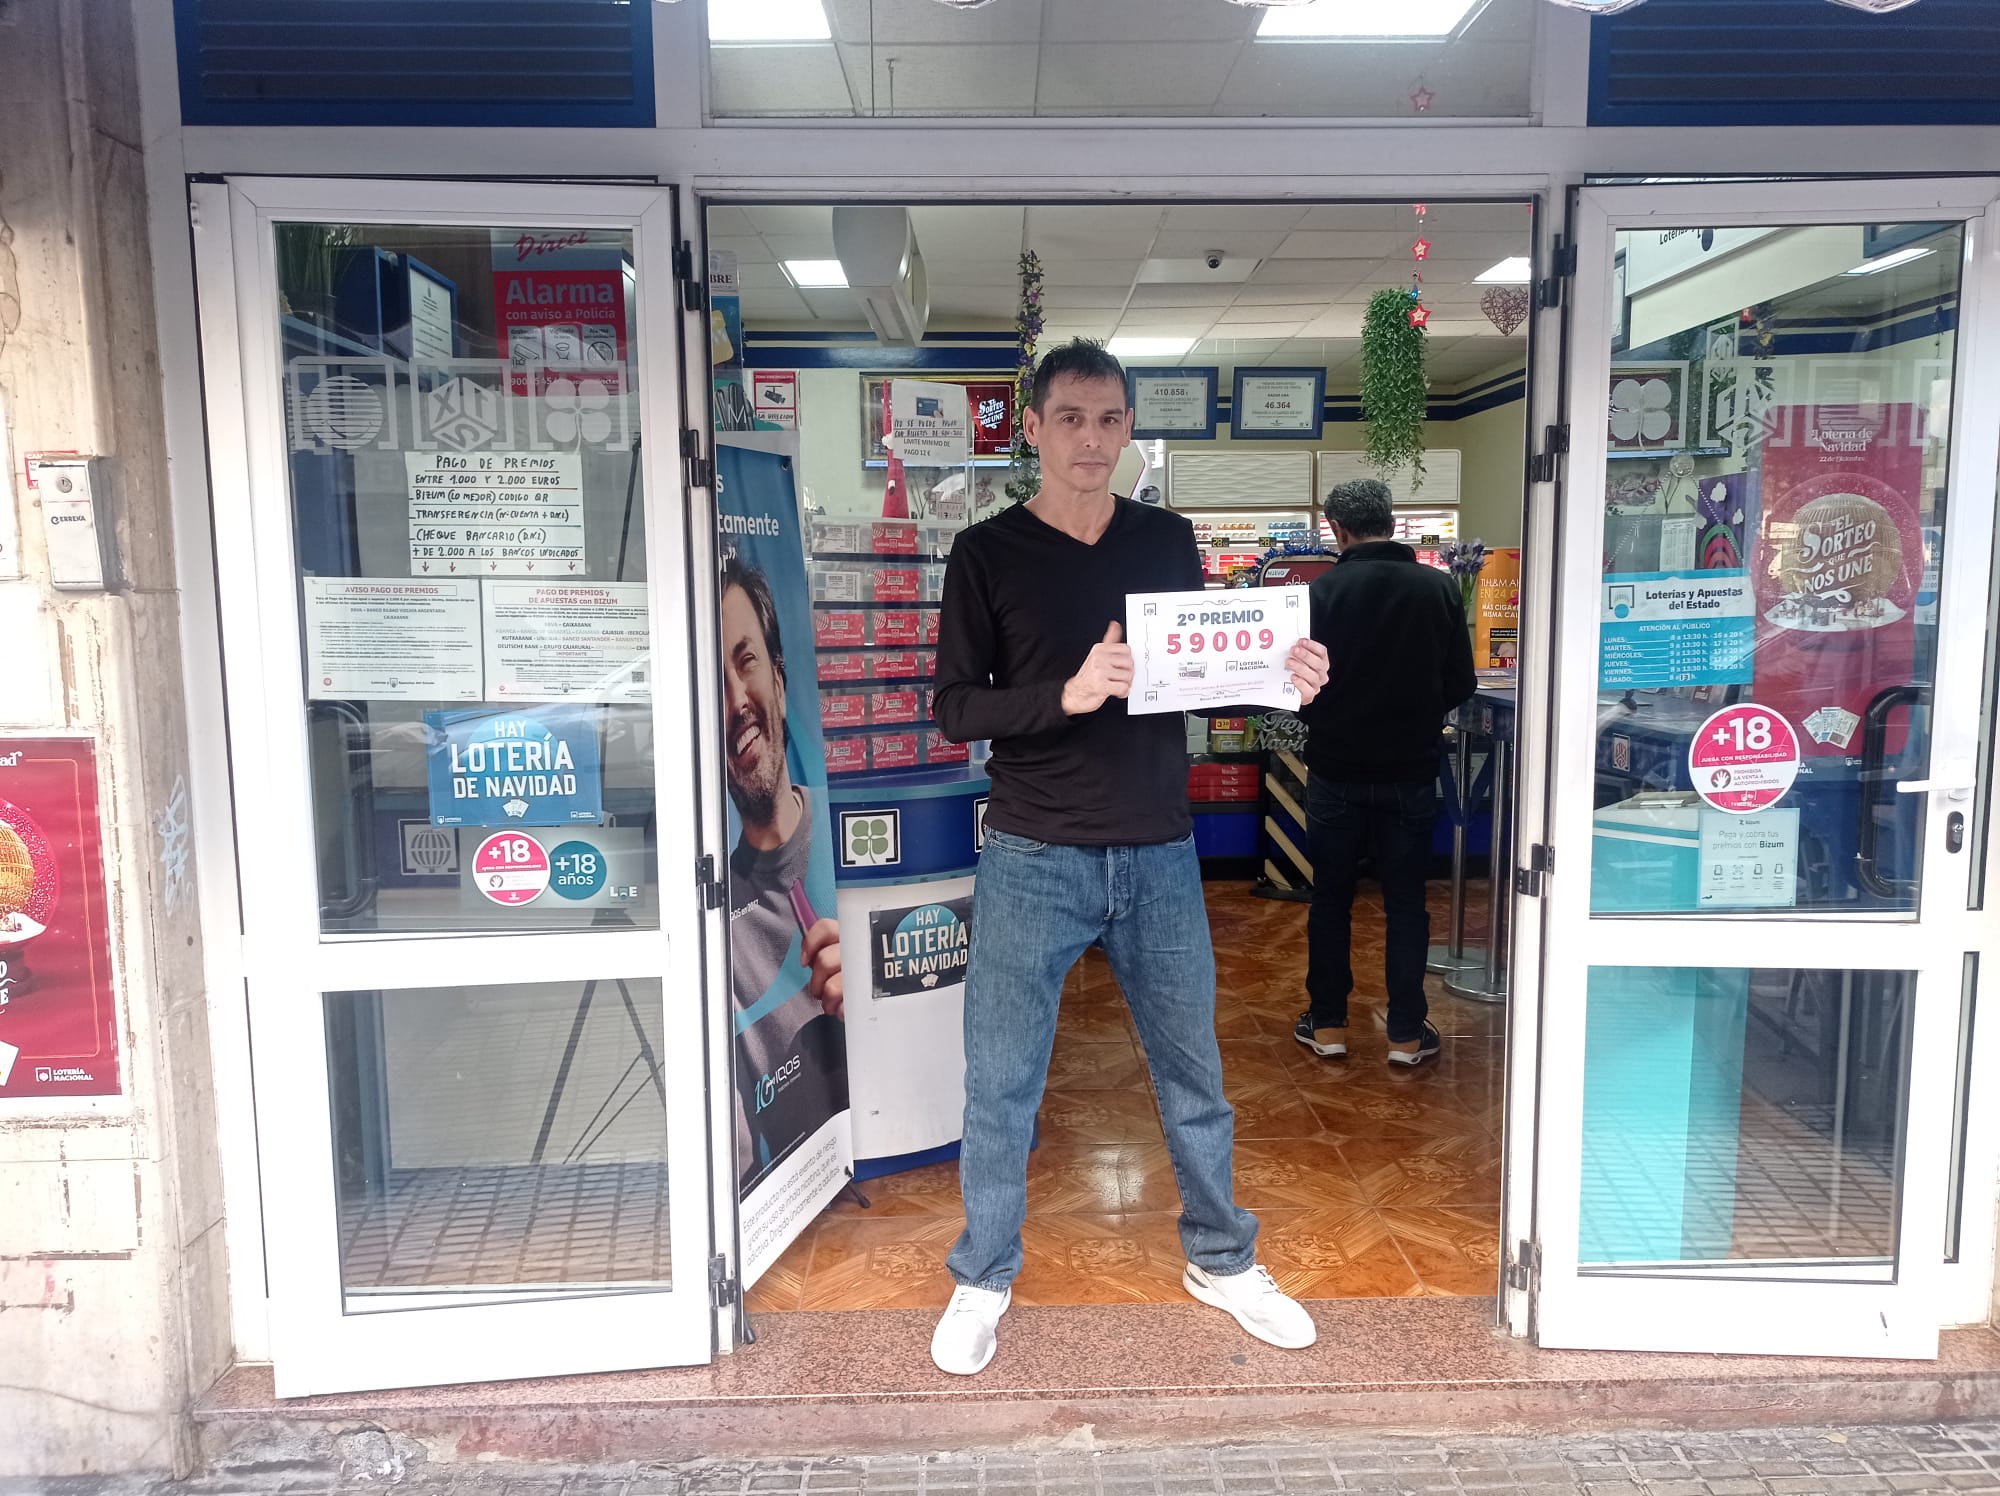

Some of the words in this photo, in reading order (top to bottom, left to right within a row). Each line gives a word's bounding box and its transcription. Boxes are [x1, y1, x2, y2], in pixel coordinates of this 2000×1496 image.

[506, 278, 614, 304] Alarma
[506, 310, 528, 320] con
[531, 308, 562, 319] aviso
[564, 310, 572, 319] a
[1859, 430, 1872, 442] de
[1820, 440, 1866, 452] Navidad
[436, 456, 467, 469] PAGO
[480, 458, 492, 469] DE
[504, 458, 556, 470] PREMIOS
[416, 474, 444, 484] ENTRE
[450, 474, 476, 484] 1.000
[486, 476, 491, 484] Y
[497, 475, 526, 484] 2.000
[532, 476, 560, 486] EUROS
[416, 490, 446, 500] BIZUM
[463, 491, 496, 504] MEJOR)
[416, 510, 494, 519] TRANSFERENCIA
[719, 513, 780, 536] tamente
[1832, 514, 1853, 531] EL
[416, 528, 456, 540] CHEQUE
[466, 530, 514, 541] BANCARIO
[1424, 536, 1432, 544] 30
[1798, 520, 1876, 563] SORTEO
[413, 548, 420, 556] +
[423, 547, 434, 556] DE
[438, 547, 464, 556] 2.000
[468, 548, 476, 556] A
[481, 548, 494, 556] LOS
[502, 548, 534, 557] BANCOS
[540, 549, 578, 558] INDICADOS
[1828, 554, 1845, 566] QUE
[1801, 570, 1834, 594] NOS
[1838, 554, 1873, 582] UNE
[1480, 589, 1490, 598] EN
[1494, 589, 1506, 598] 24
[1646, 590, 1686, 600] Loterías
[1688, 592, 1694, 600] y
[1697, 588, 1743, 598] Apuestas
[1669, 600, 1684, 610] del
[1686, 600, 1720, 608] Estado
[1177, 614, 1196, 626] 2º
[1200, 609, 1264, 626] PREMIO
[1166, 628, 1274, 654] 59009
[495, 721, 526, 738] HAY
[1712, 716, 1772, 751] +18
[451, 733, 574, 773] LOTERÍA
[1734, 752, 1787, 760] RESPONSABILIDAD
[454, 777, 479, 798] DE
[486, 774, 576, 798] NAVIDAD
[1719, 830, 1738, 840] Paga
[1746, 830, 1765, 838] cobra
[488, 840, 531, 864] +18
[1712, 840, 1742, 850] premios
[1760, 840, 1784, 849] Bizum
[555, 854, 596, 874] +18
[558, 874, 594, 886] años
[916, 908, 940, 926] HAY
[882, 917, 968, 959] LOTERÍA
[884, 961, 903, 978] DE
[908, 950, 968, 976] NAVIDAD
[776, 1054, 800, 1084] IQOS
